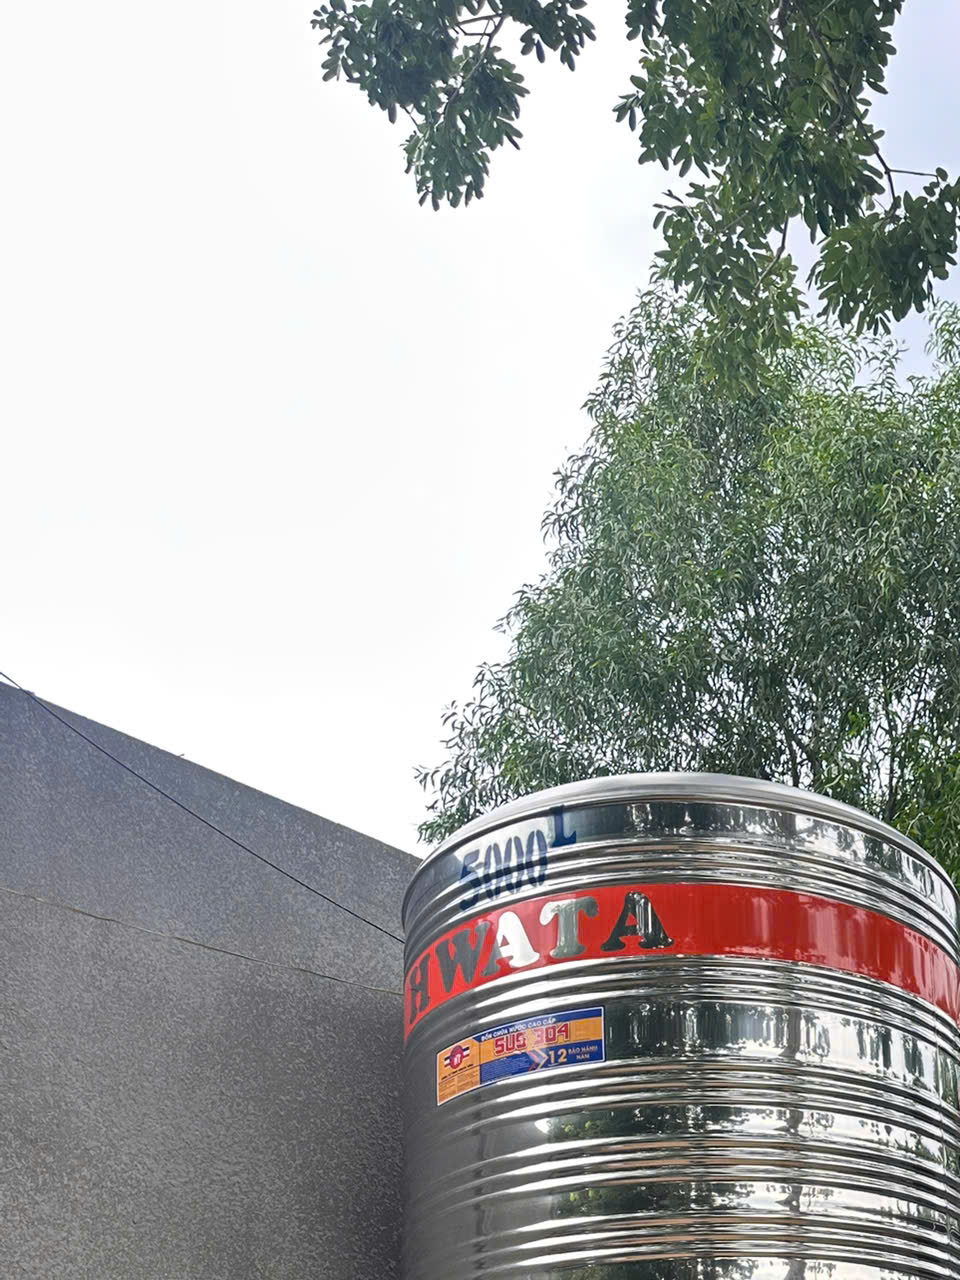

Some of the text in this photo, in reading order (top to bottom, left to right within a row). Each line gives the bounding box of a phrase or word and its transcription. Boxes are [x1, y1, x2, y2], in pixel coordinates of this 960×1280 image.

[494, 1022, 570, 1054] SUS 304
[548, 1048, 568, 1064] 12
